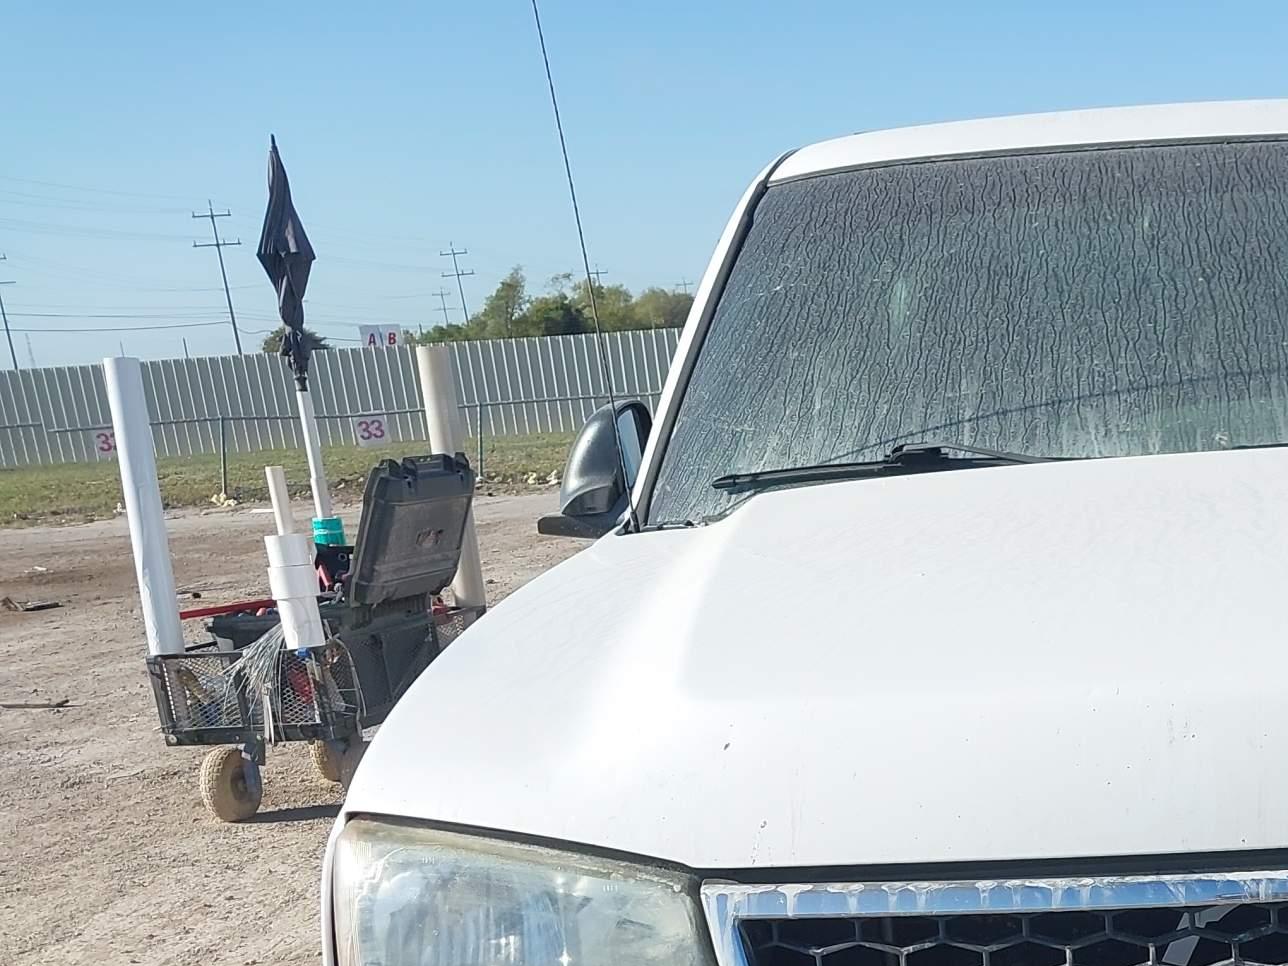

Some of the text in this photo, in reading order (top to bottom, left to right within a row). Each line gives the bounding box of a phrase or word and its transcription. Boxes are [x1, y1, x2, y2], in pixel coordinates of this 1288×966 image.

[368, 332, 397, 346] A B
[358, 419, 385, 440] 33
